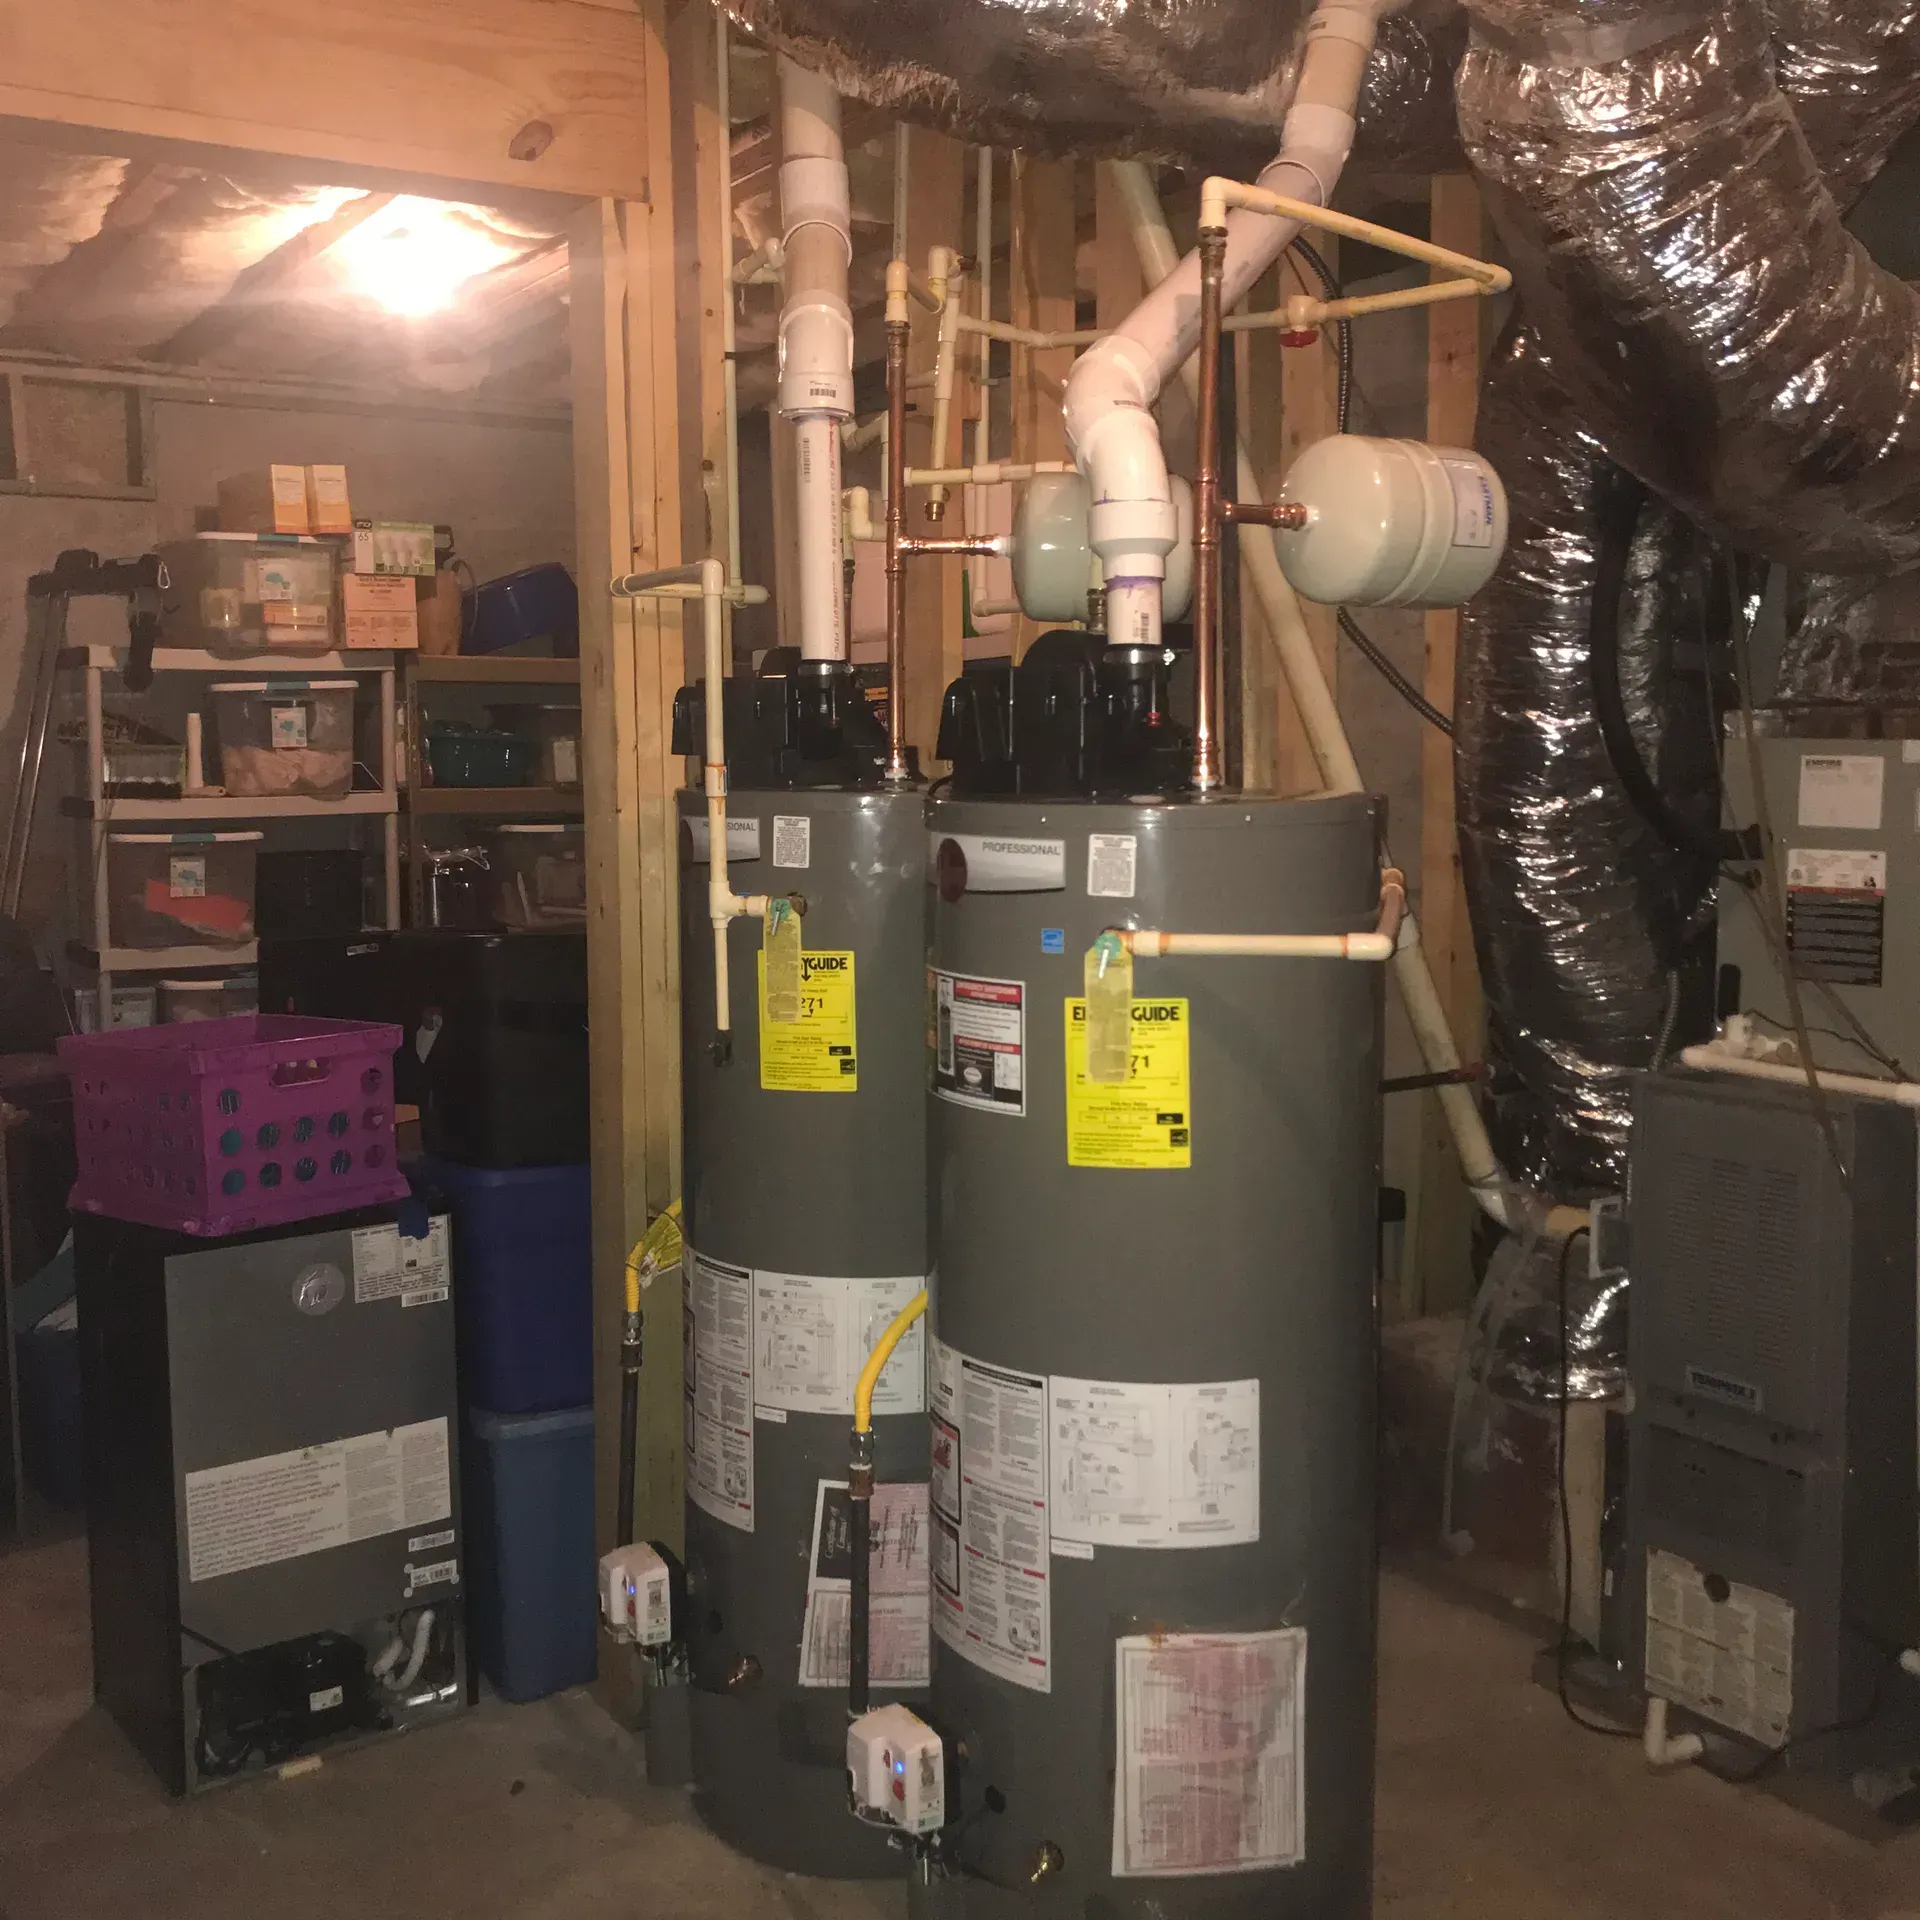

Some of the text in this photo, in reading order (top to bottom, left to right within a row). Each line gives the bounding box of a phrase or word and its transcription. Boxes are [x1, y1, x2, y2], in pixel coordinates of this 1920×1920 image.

[358, 532, 369, 541] 65
[982, 841, 1061, 856] PROFESSIONAL
[801, 957, 848, 971] YGUIDE
[1130, 1055, 1149, 1068] 71
